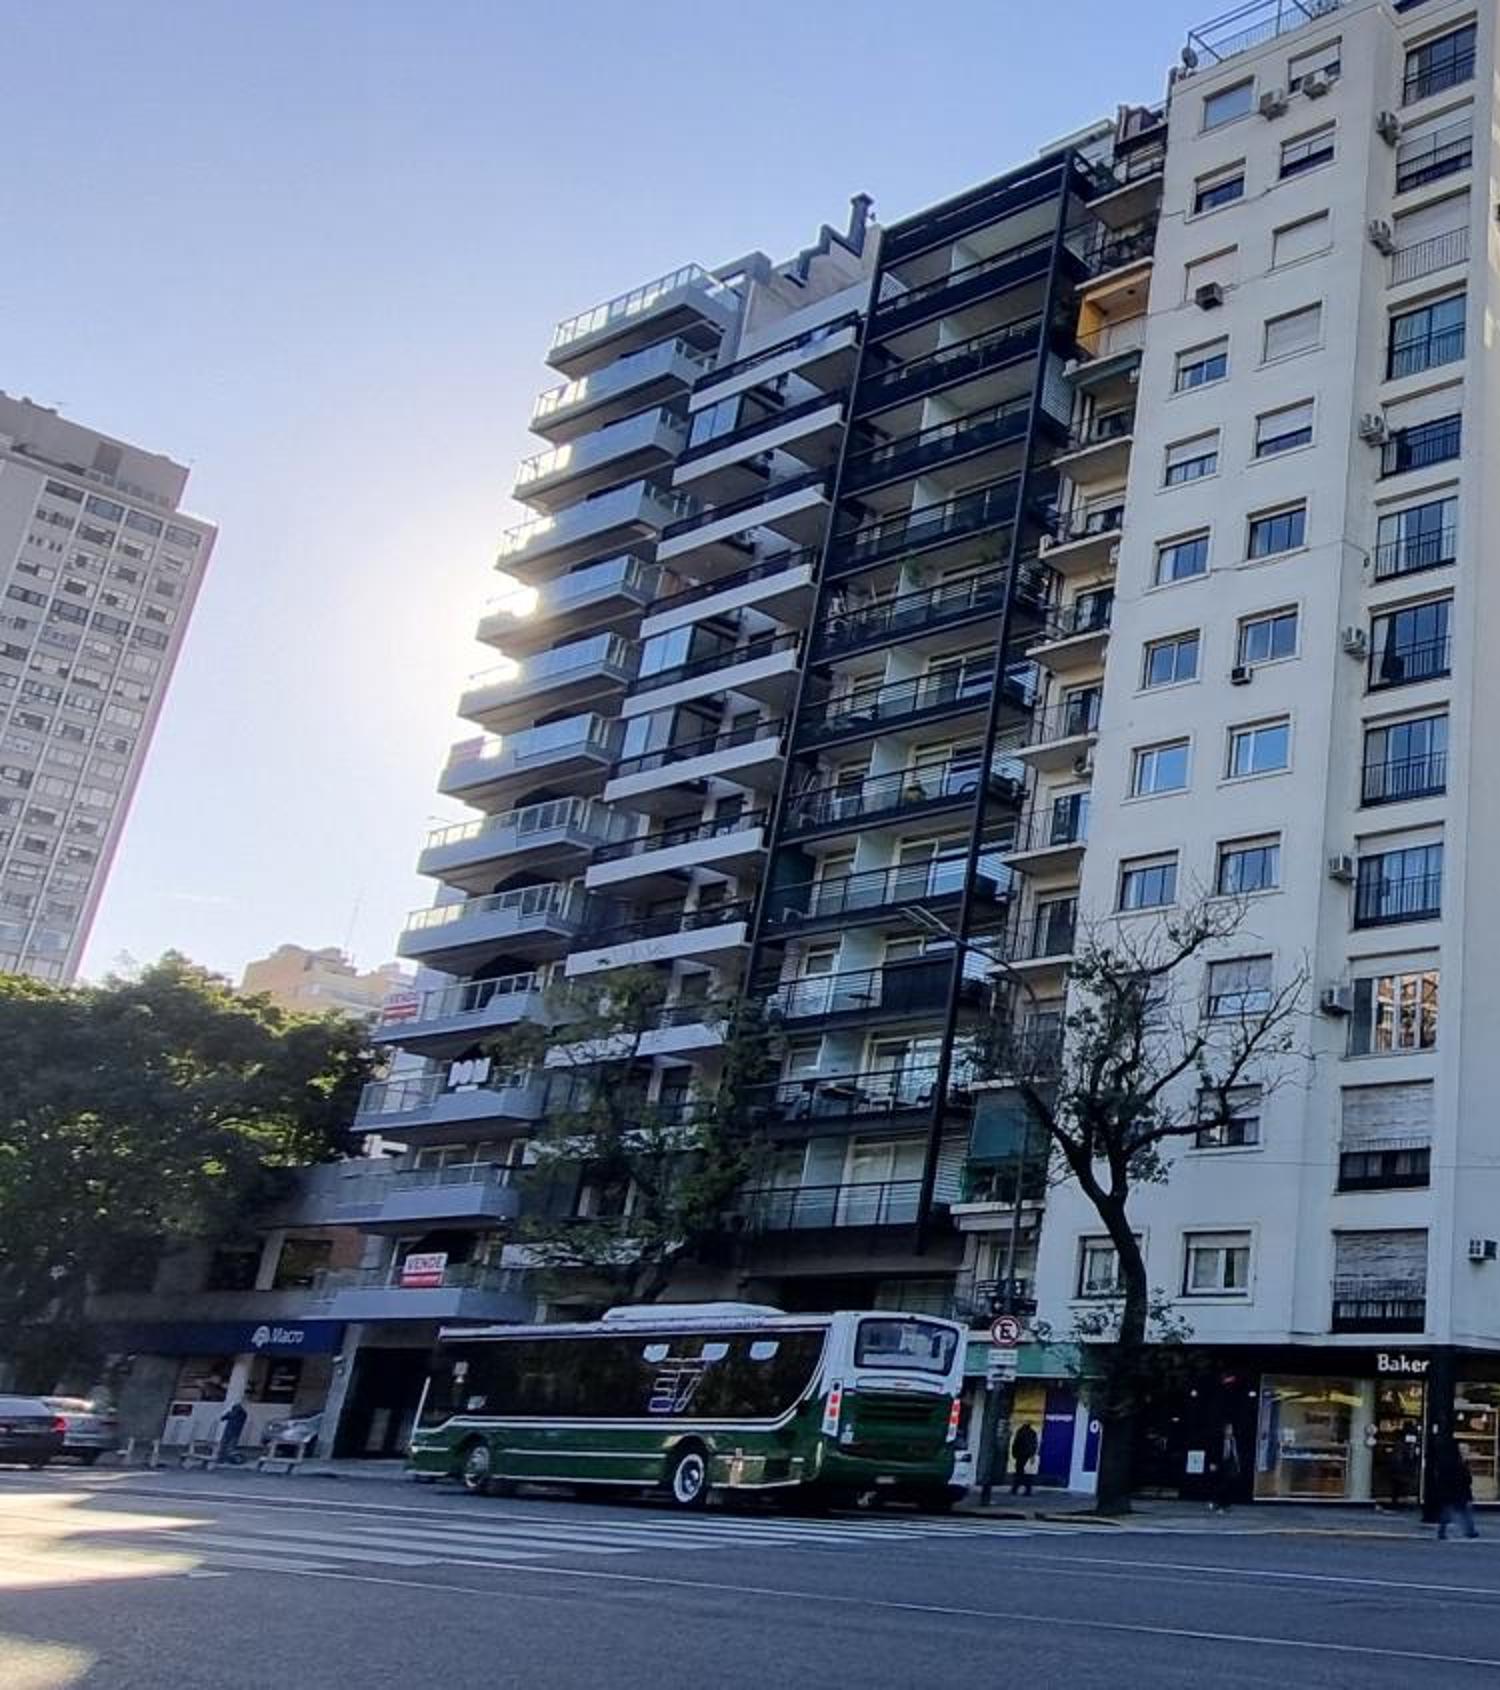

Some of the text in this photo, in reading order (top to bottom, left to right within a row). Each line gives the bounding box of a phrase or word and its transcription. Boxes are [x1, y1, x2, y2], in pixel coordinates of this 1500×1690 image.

[407, 1255, 445, 1270] VENDE
[272, 1327, 305, 1344] Macro
[1377, 1353, 1430, 1373] Baker
